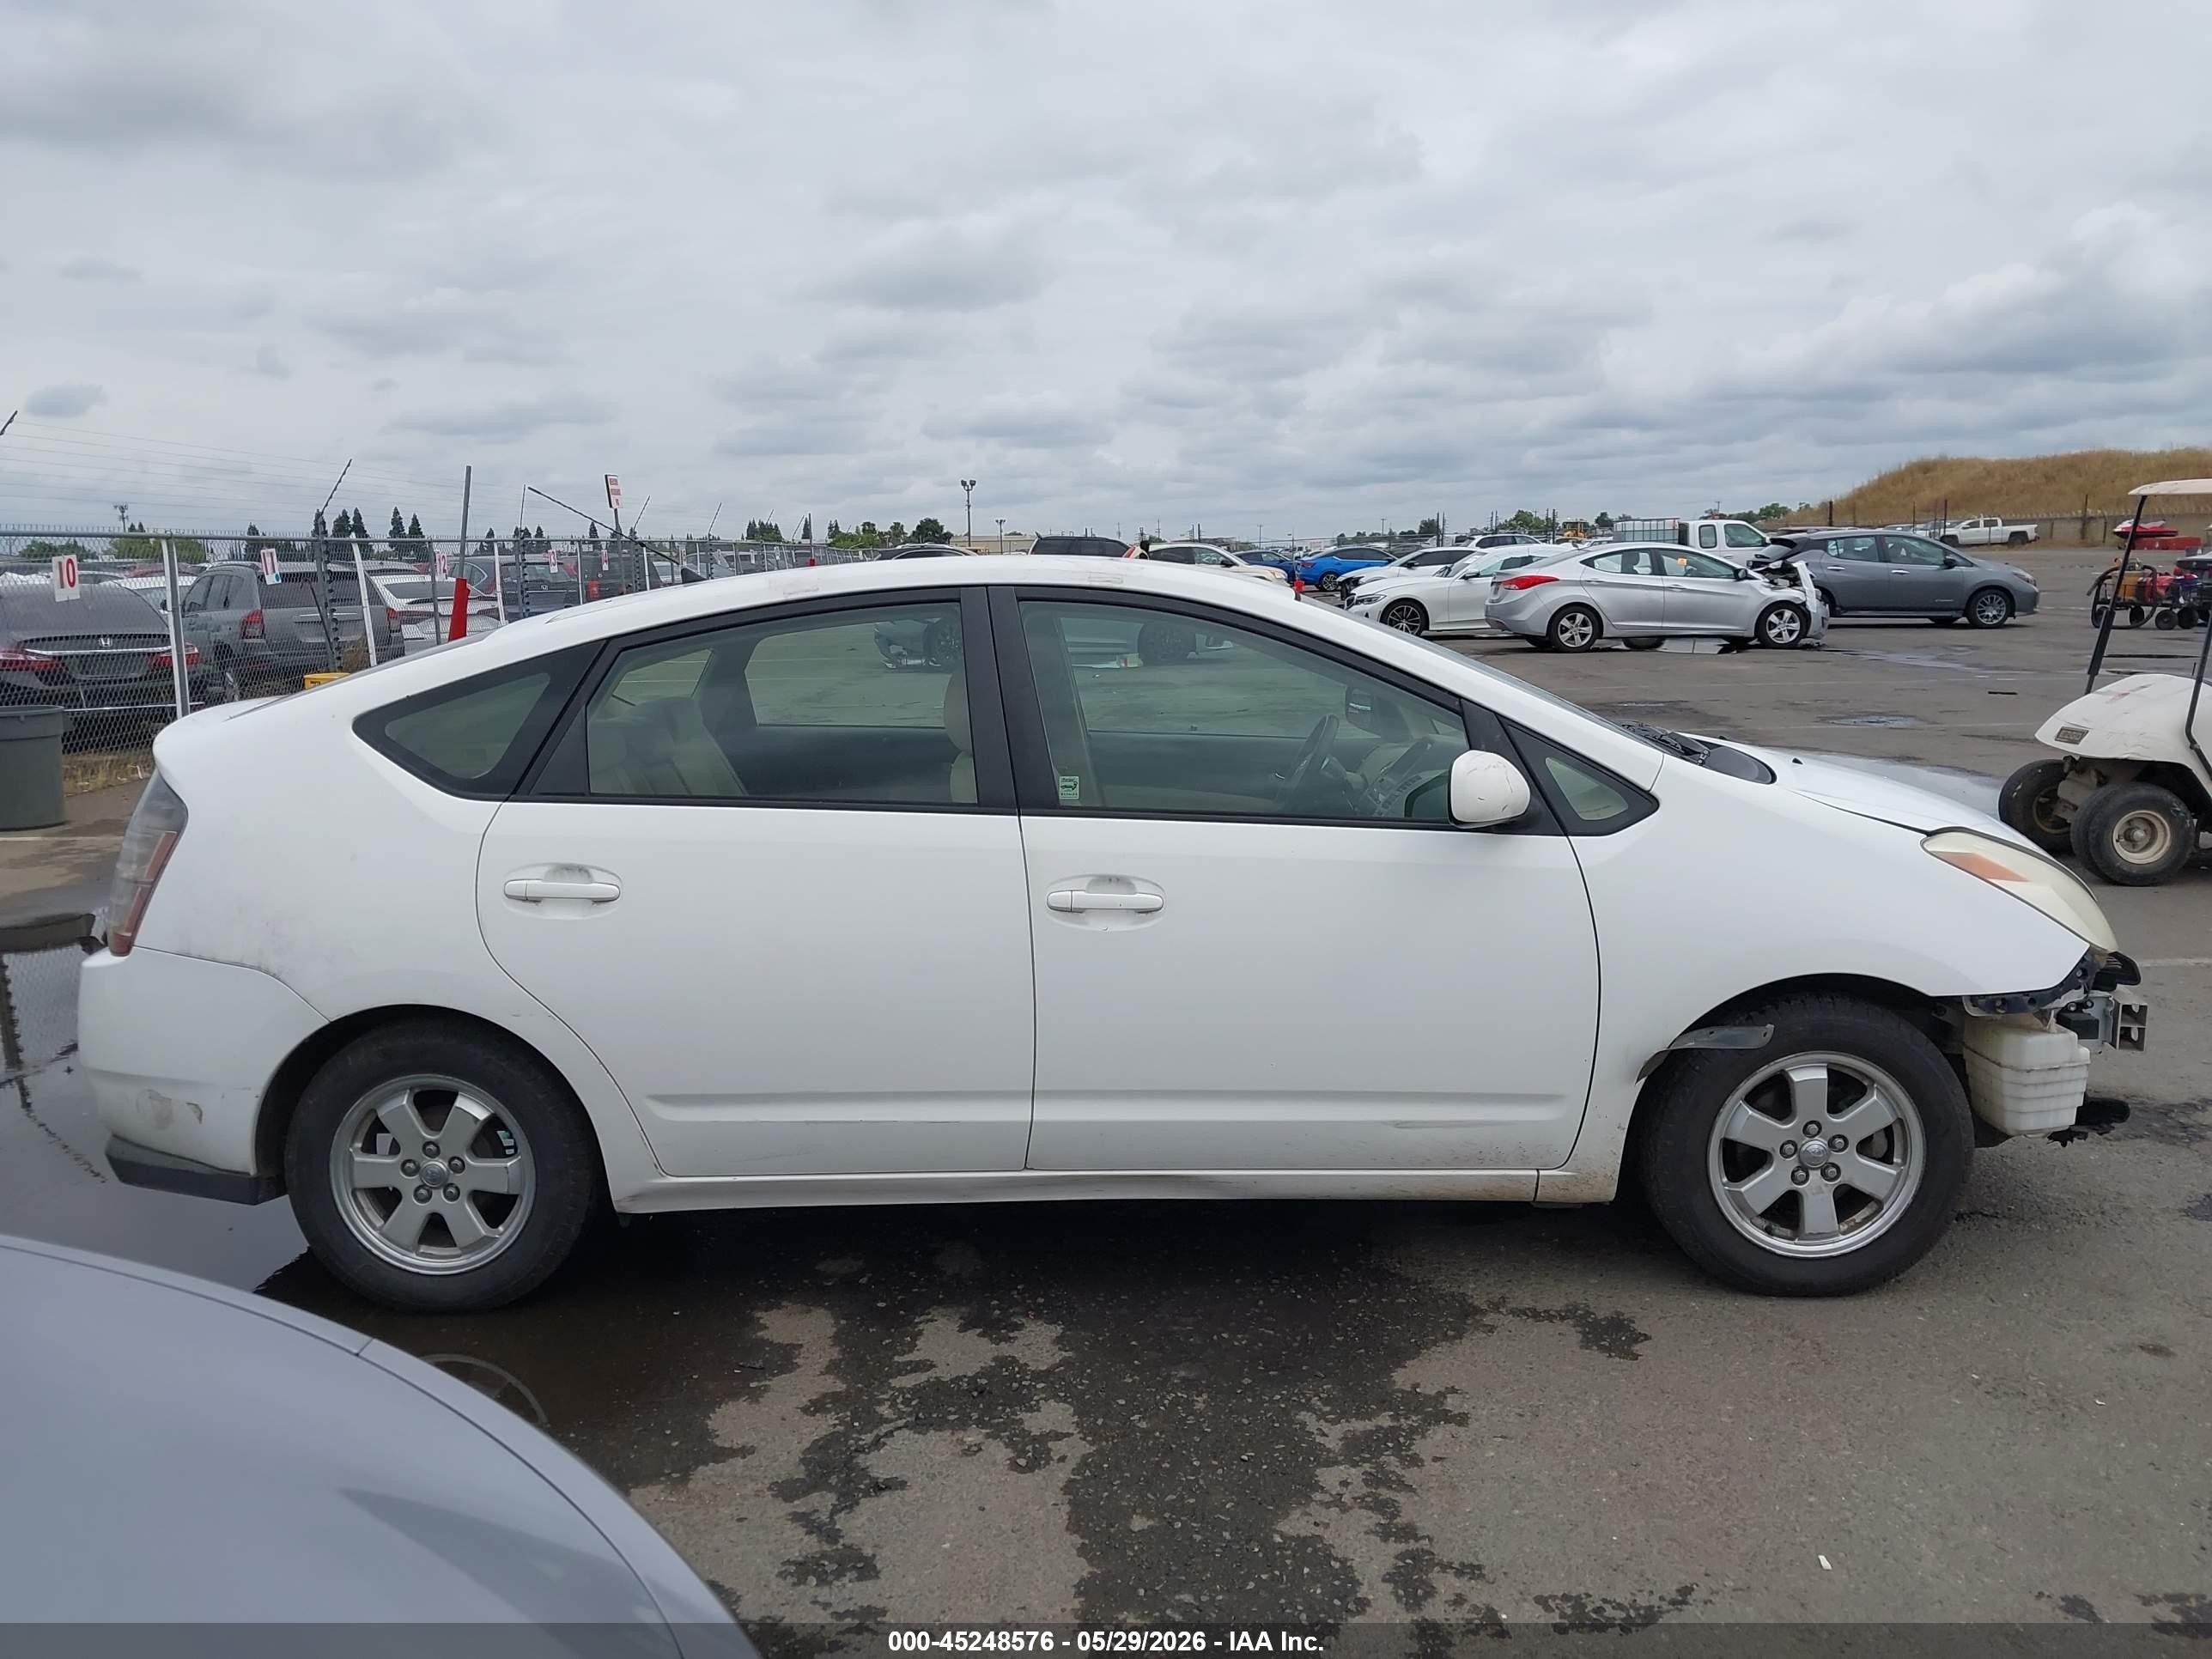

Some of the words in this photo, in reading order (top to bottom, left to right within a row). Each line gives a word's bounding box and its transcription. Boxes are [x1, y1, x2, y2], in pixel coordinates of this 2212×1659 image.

[58, 558, 76, 588] 10
[262, 551, 276, 575] 11
[438, 554, 447, 574] 12
